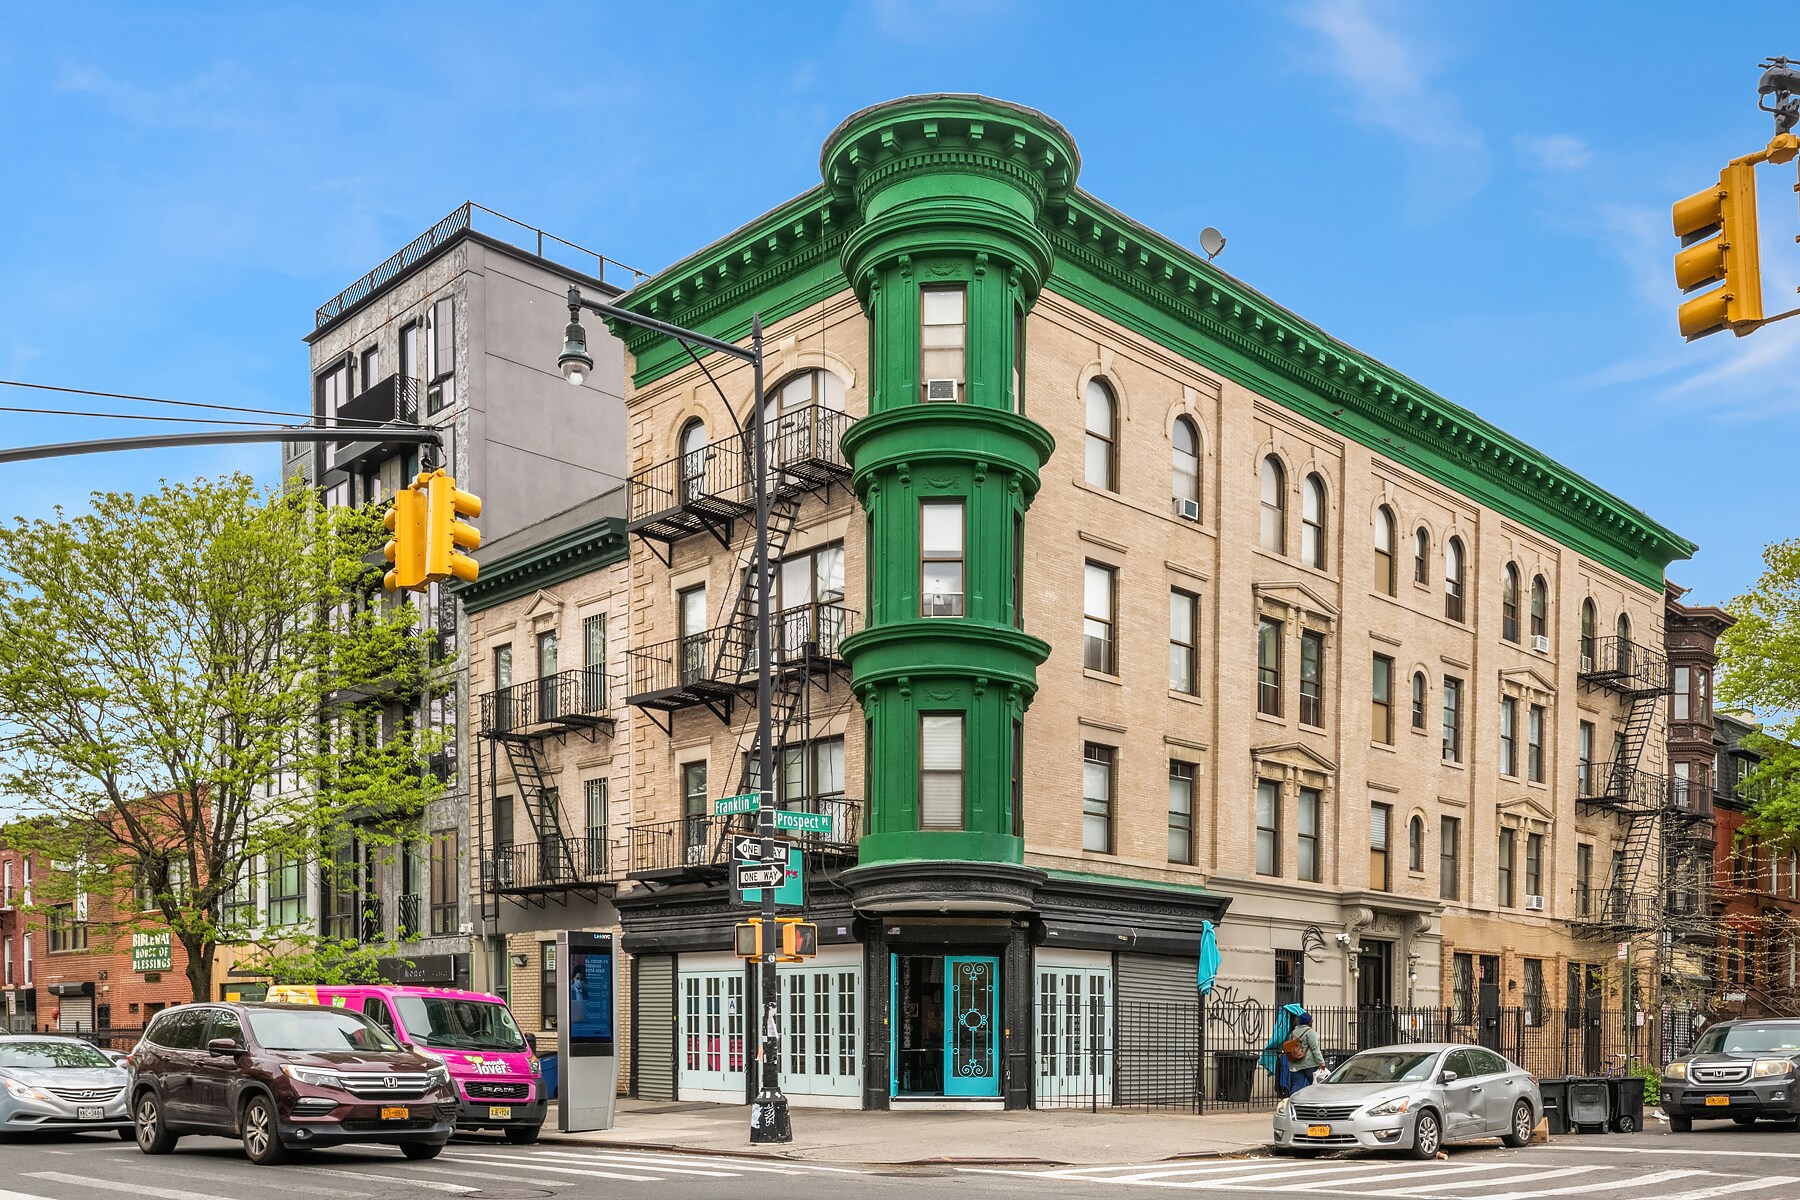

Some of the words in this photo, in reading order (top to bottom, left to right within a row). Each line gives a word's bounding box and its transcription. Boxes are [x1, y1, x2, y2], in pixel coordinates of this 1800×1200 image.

[715, 796, 749, 814] Franklin
[777, 813, 819, 831] Prospect
[821, 817, 828, 826] Pl
[742, 843, 758, 855] ONE
[744, 871, 757, 882] ONE
[763, 870, 778, 881] WAY
[159, 947, 169, 957] OF
[132, 958, 171, 970] BLESSINGS
[476, 1062, 507, 1075] lover
